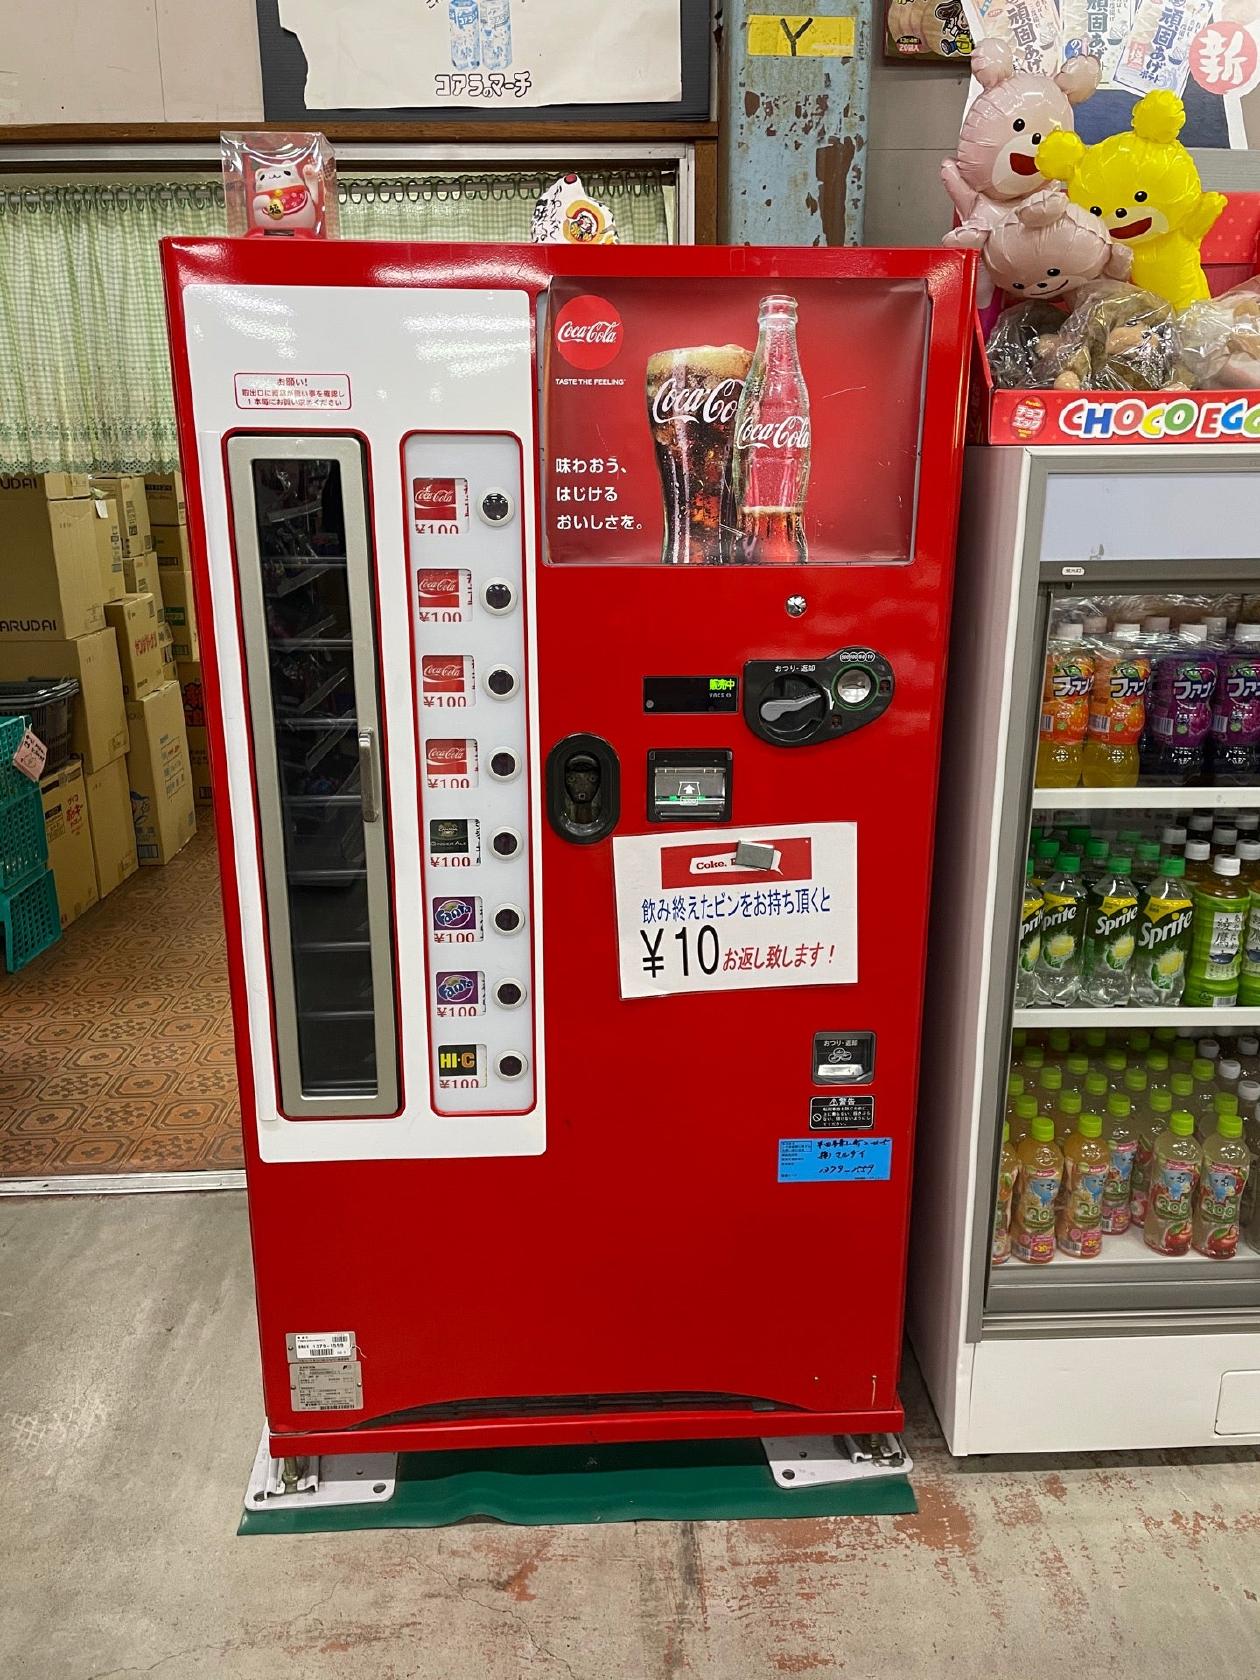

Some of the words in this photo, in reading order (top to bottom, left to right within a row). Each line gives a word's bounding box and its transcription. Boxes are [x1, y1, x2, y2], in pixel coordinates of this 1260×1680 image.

[780, 17, 813, 57] Y
[1146, 6, 1185, 74] 頑固あげ
[1198, 29, 1248, 85] 新
[434, 70, 532, 98] コアラのマーチ
[557, 320, 622, 345] Coca-Cola
[555, 378, 577, 386] TASTE
[593, 378, 625, 386] FEELING
[652, 377, 746, 424] Coca-Co
[1060, 400, 1197, 436] CHOCO
[555, 457, 628, 475] 味わおう、
[556, 486, 618, 502] はじける
[557, 514, 643, 531] おいしさを。
[1111, 678, 1148, 698] ファン
[1174, 681, 1213, 700] ファン
[696, 860, 728, 871] Coke.
[641, 886, 832, 924] 飲み終えたビンをお持ち頂くと
[1042, 906, 1077, 931] prite
[1095, 906, 1138, 936] Sprite
[1138, 910, 1193, 950] Sprite
[639, 924, 720, 979] ¥10
[722, 942, 836, 972] お返し致します！
